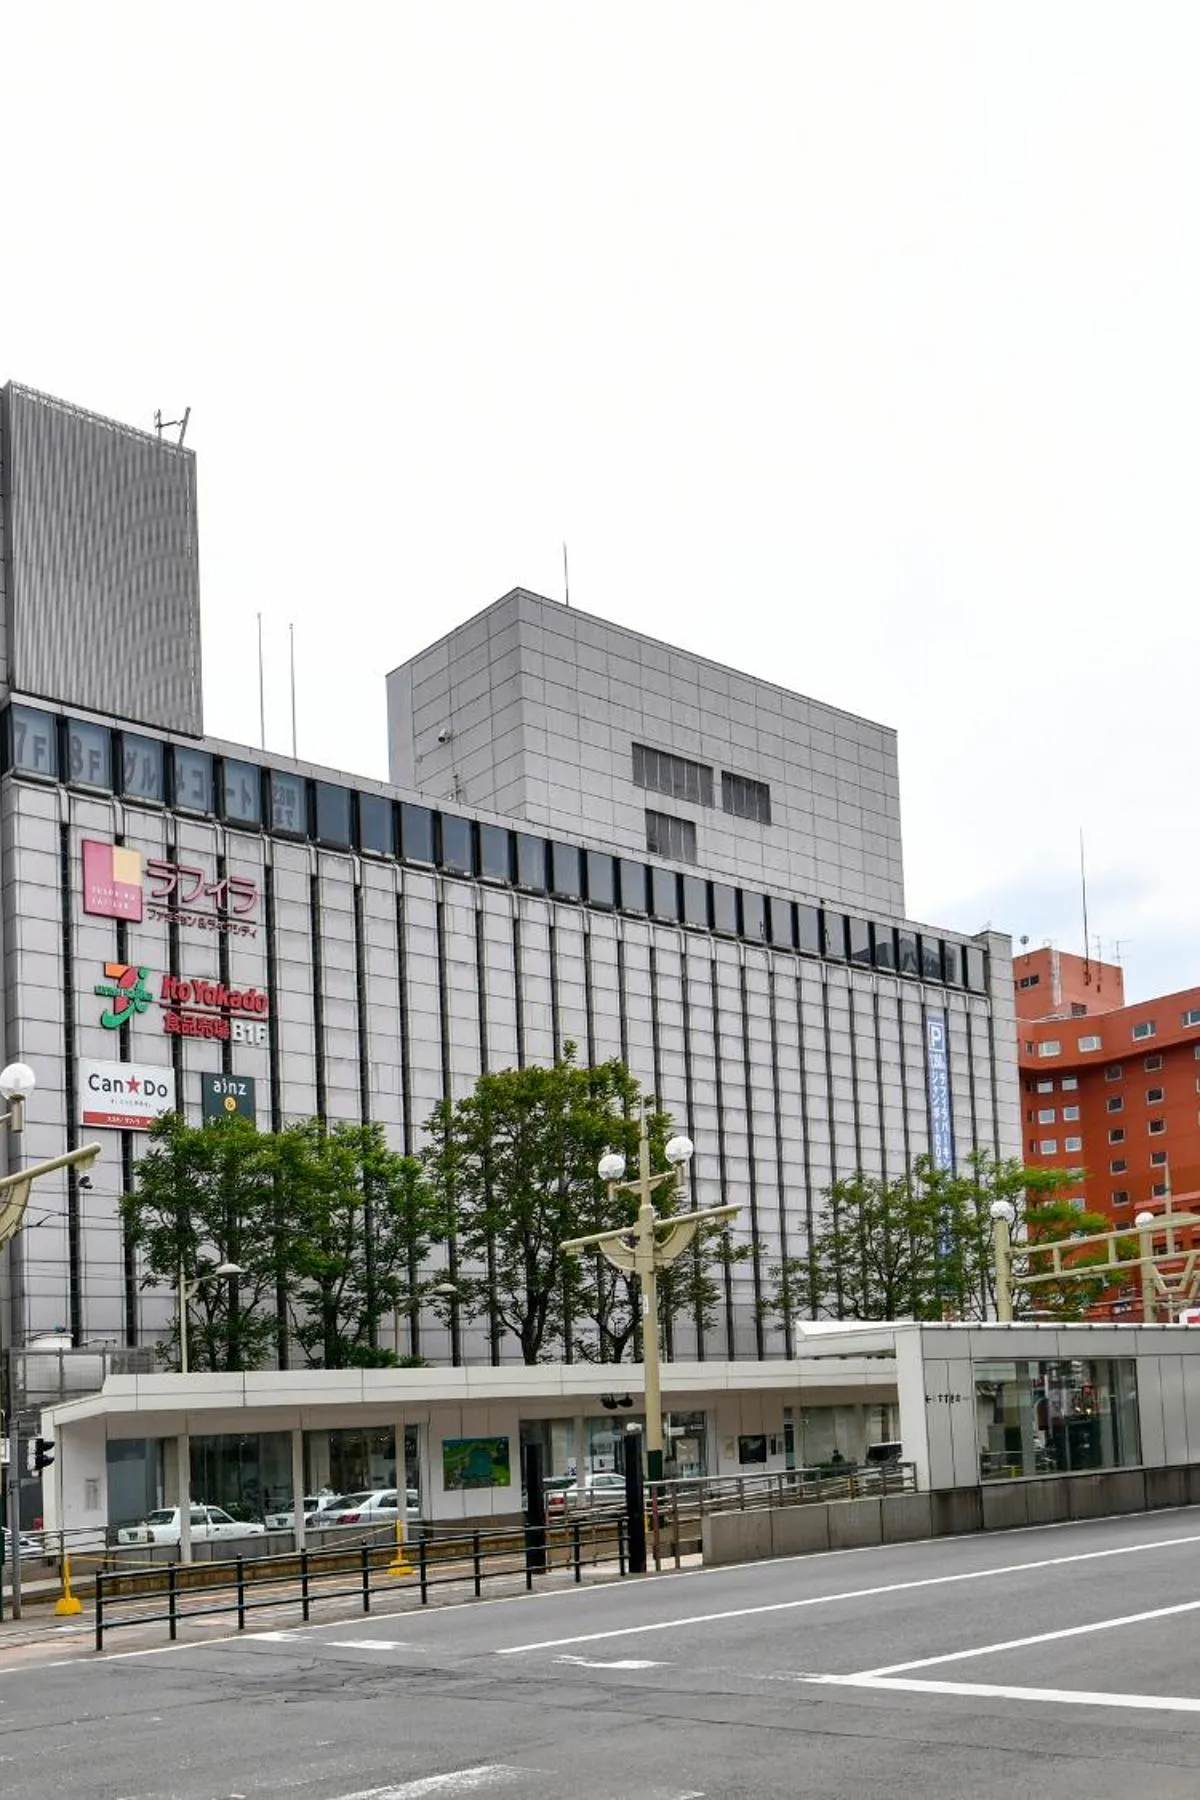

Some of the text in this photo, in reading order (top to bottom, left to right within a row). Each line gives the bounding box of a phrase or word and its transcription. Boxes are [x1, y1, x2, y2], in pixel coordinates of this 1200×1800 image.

[15, 719, 47, 769] 7F
[70, 734, 102, 781] 8F
[146, 858, 259, 914] ラフィラ
[160, 975, 268, 1013] ItoYokado
[163, 1011, 267, 1046] 食品売場 B1F
[931, 1027, 942, 1047] P
[213, 1078, 247, 1096] ainz
